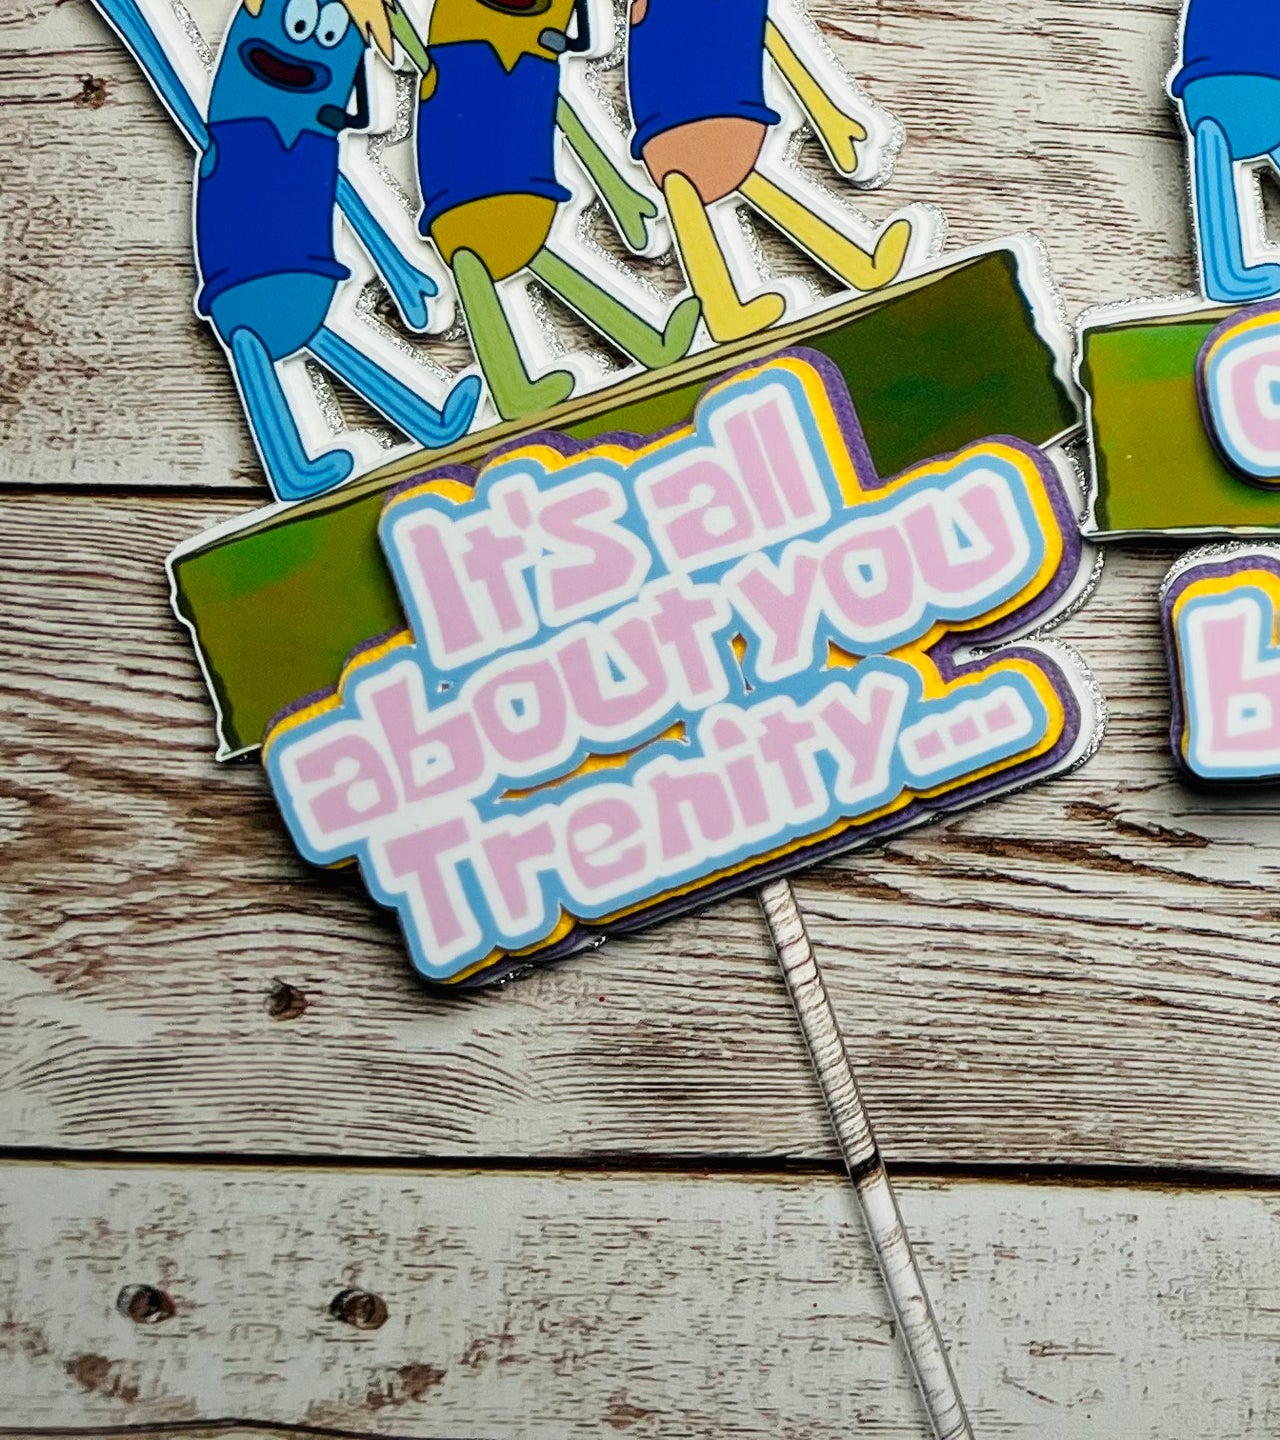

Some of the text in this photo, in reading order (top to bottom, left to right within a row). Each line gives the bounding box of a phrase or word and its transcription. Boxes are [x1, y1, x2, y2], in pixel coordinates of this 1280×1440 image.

[411, 402, 816, 652] It's all
[296, 486, 1014, 833] about you
[387, 688, 1014, 946] Trenity...
